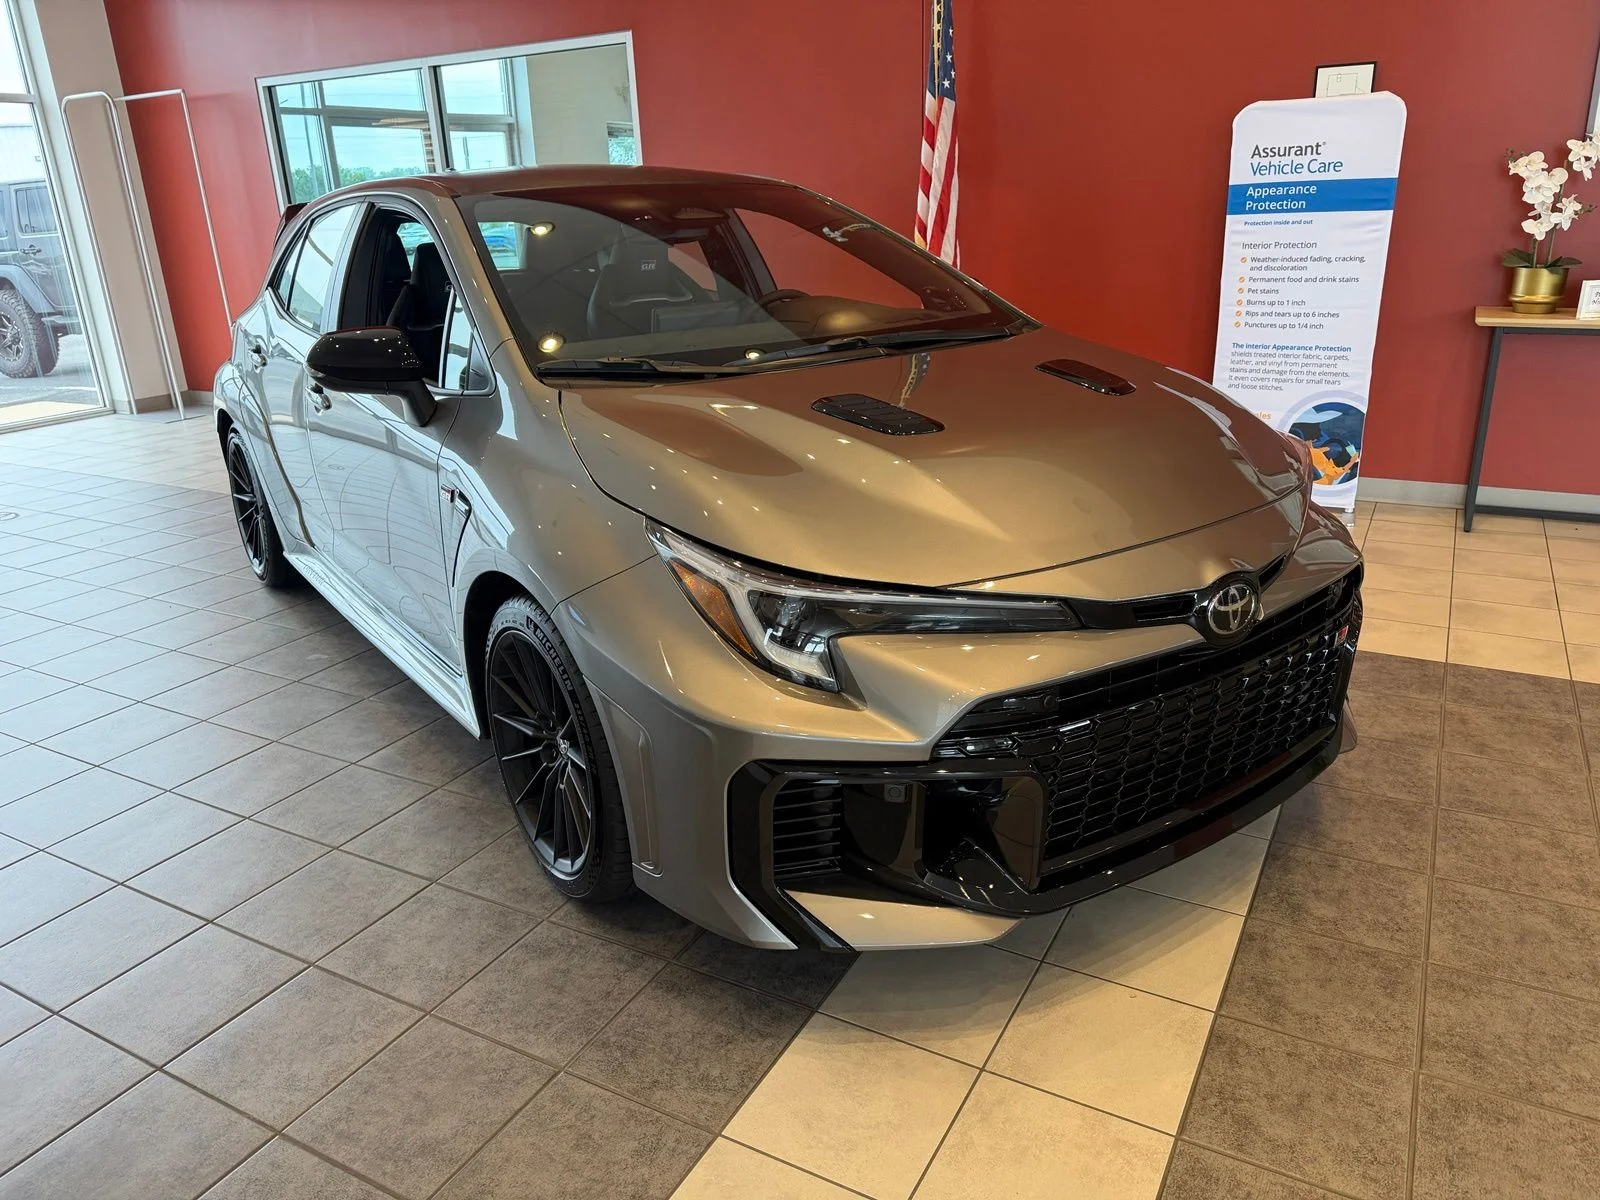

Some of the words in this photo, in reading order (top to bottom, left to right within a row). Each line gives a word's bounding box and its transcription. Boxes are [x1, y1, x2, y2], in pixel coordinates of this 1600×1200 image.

[1251, 160, 1304, 176] Vehicle
[1308, 159, 1343, 173] Care
[1247, 184, 1317, 198] Appearance
[1246, 200, 1305, 210] Protection
[1275, 241, 1317, 249] Protection
[1335, 255, 1366, 263] cracking,
[1272, 344, 1313, 352] Appearance
[1255, 359, 1267, 367] and
[1268, 360, 1283, 368] vinyl
[1284, 360, 1299, 368] from
[1262, 368, 1288, 377] damage
[1272, 377, 1294, 385] repairs
[534, 629, 574, 691] MICHELIN
